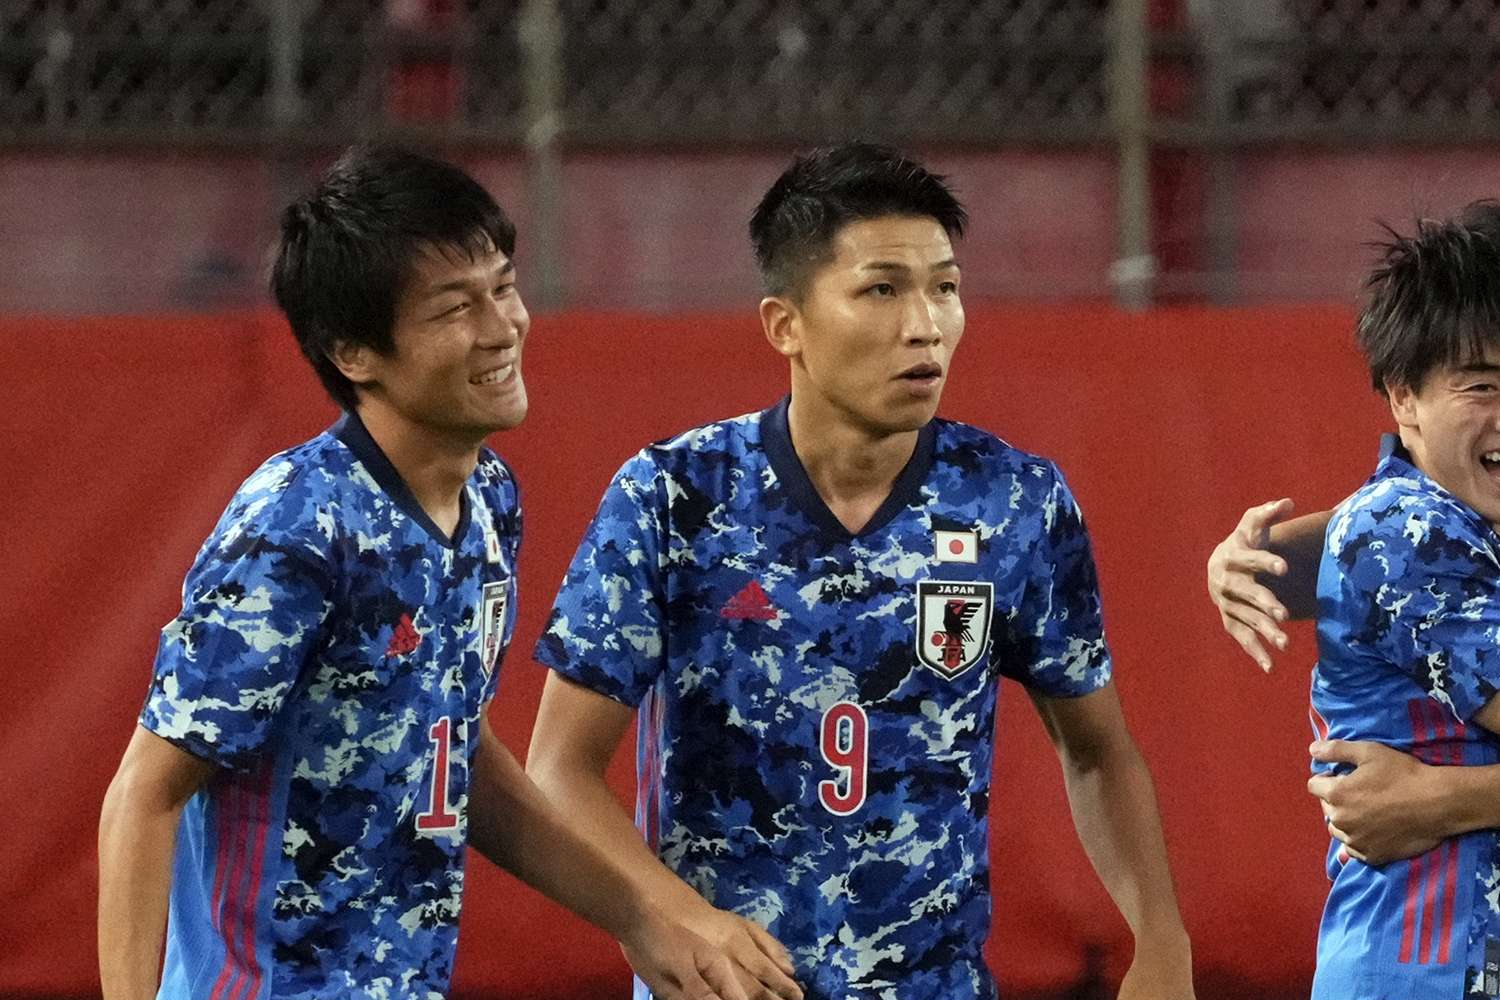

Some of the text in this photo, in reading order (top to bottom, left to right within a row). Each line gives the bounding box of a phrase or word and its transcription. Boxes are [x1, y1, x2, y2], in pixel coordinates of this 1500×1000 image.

[937, 585, 976, 595] JAPAN
[414, 715, 460, 832] 1
[818, 701, 870, 817] 9
